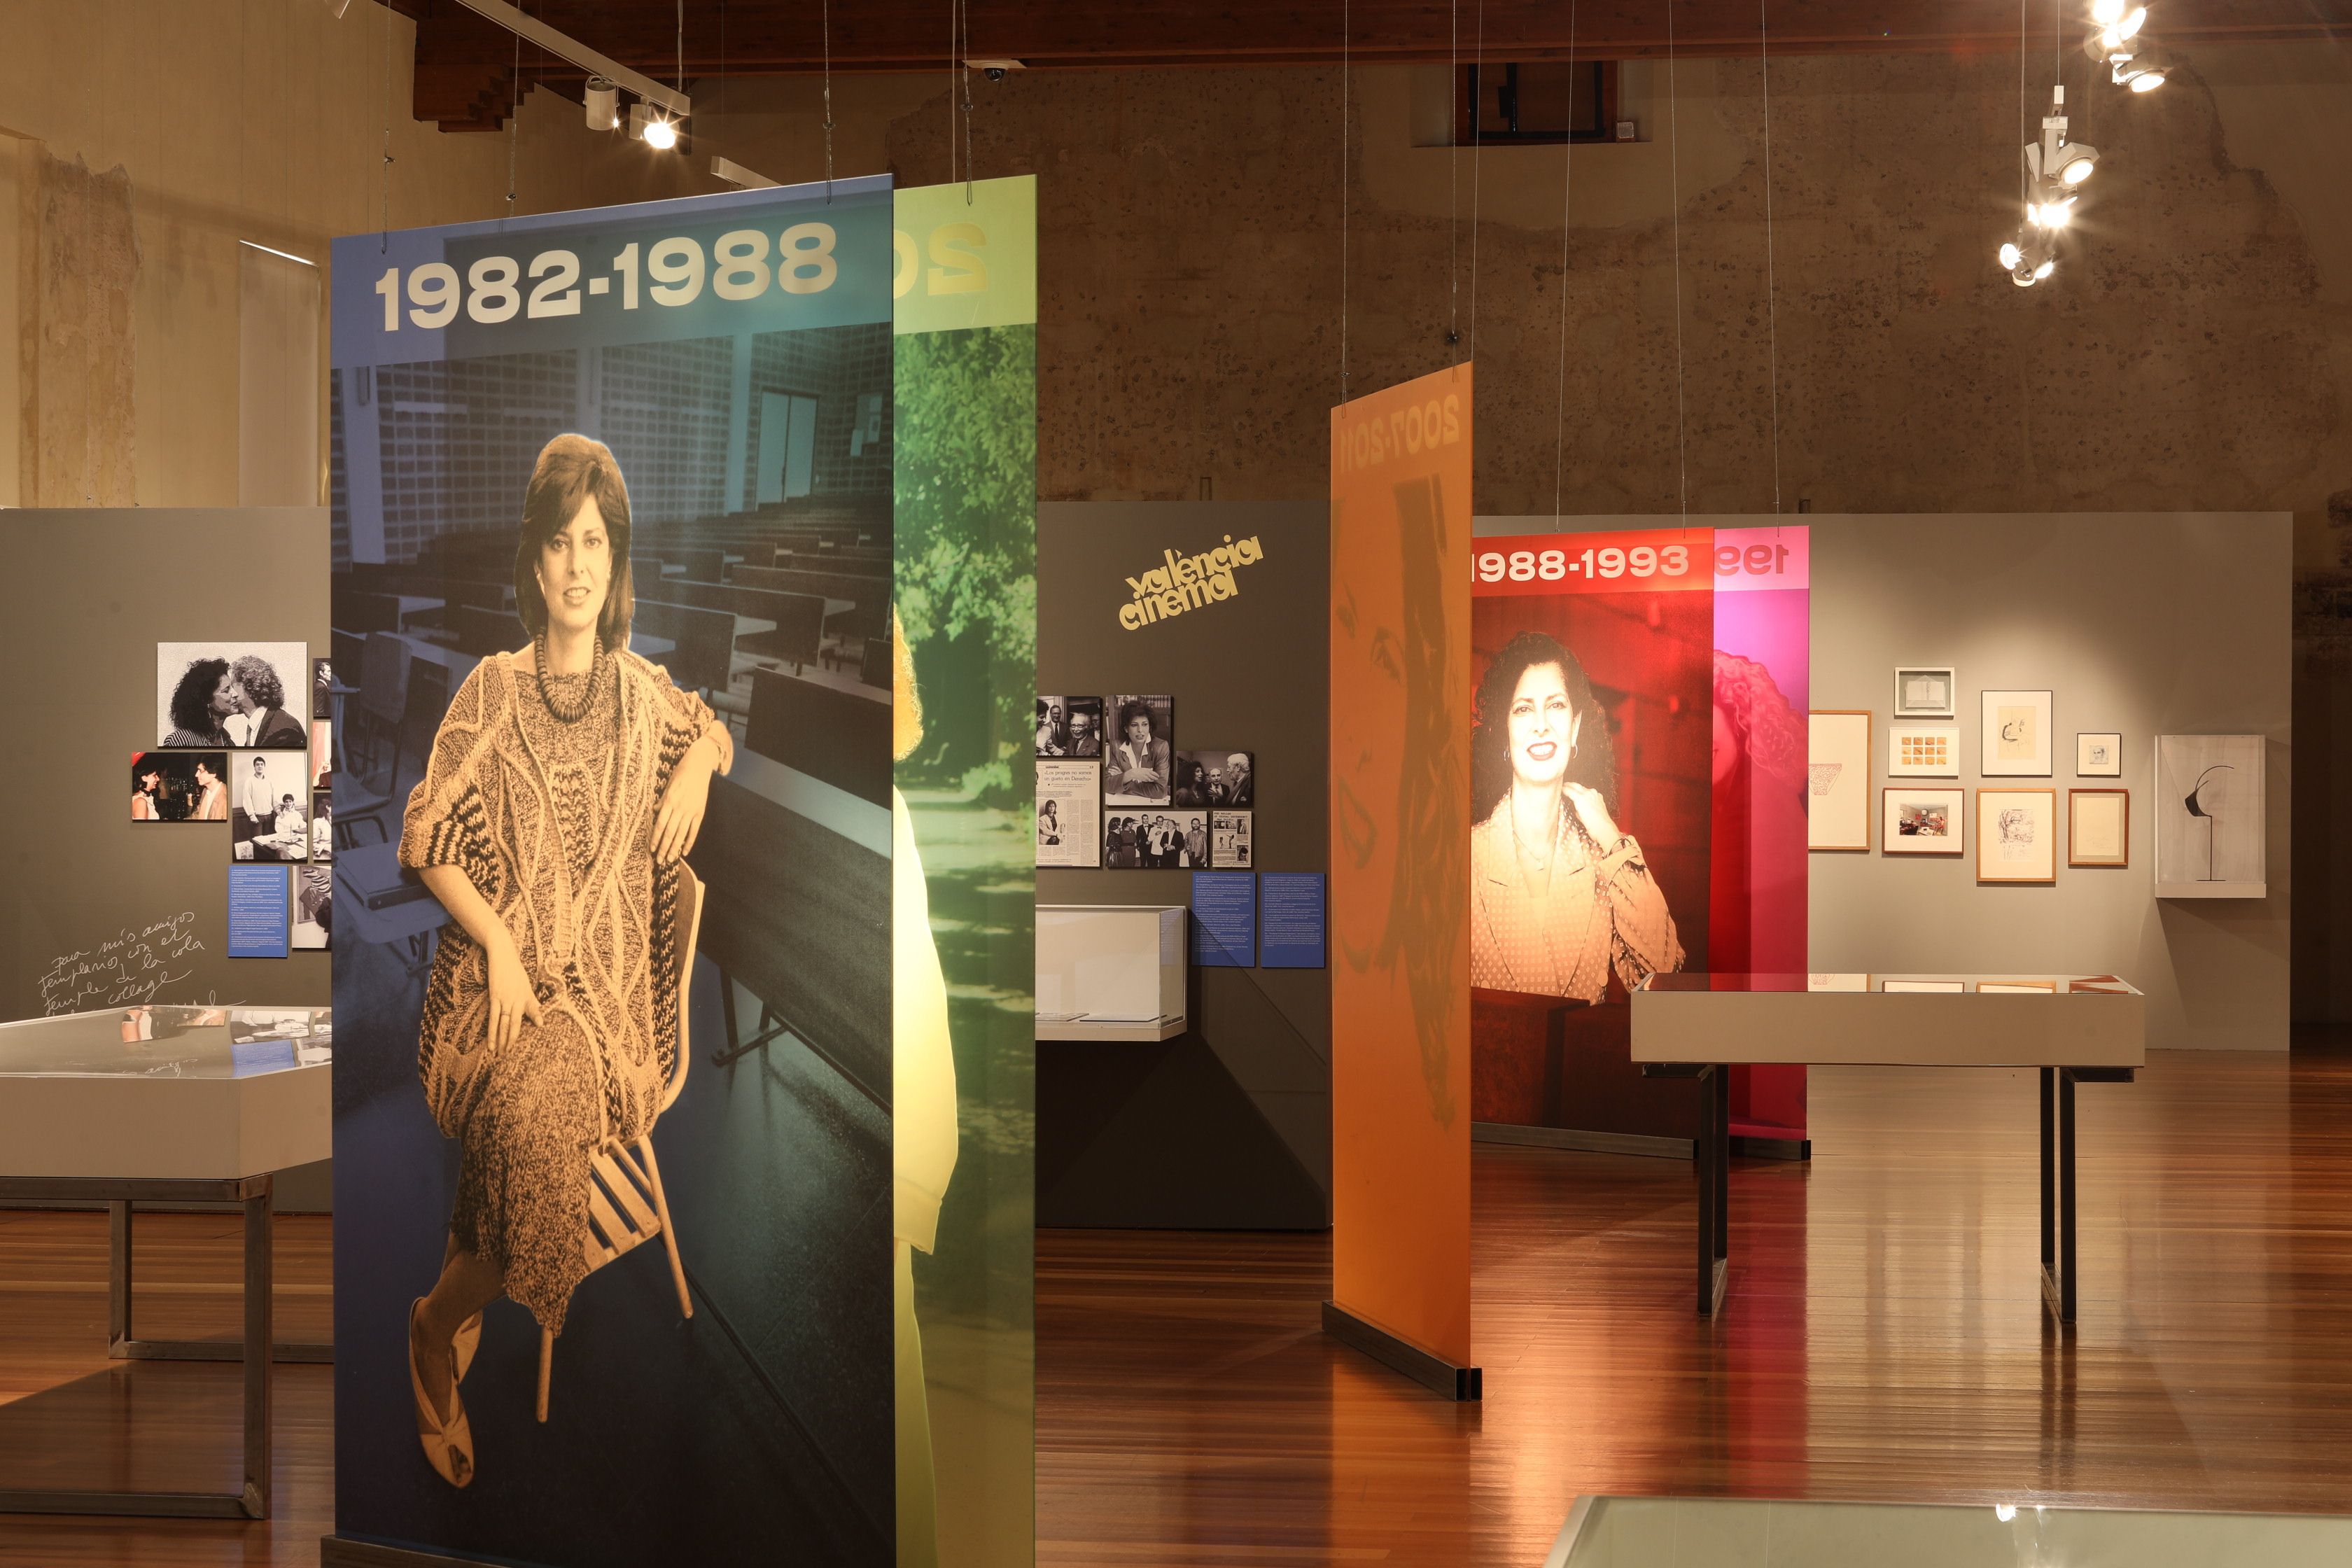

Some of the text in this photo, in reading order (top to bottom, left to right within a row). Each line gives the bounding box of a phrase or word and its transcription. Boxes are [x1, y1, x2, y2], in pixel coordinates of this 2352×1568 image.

[375, 222, 838, 331] 1982-1988
[1471, 545, 1689, 582] 988-1993
[1119, 570, 1238, 631] cinema
[51, 950, 90, 975] para
[142, 911, 195, 937] amigos
[127, 944, 152, 959] con
[161, 929, 190, 946] el
[141, 953, 166, 970] la
[172, 935, 206, 958] cola
